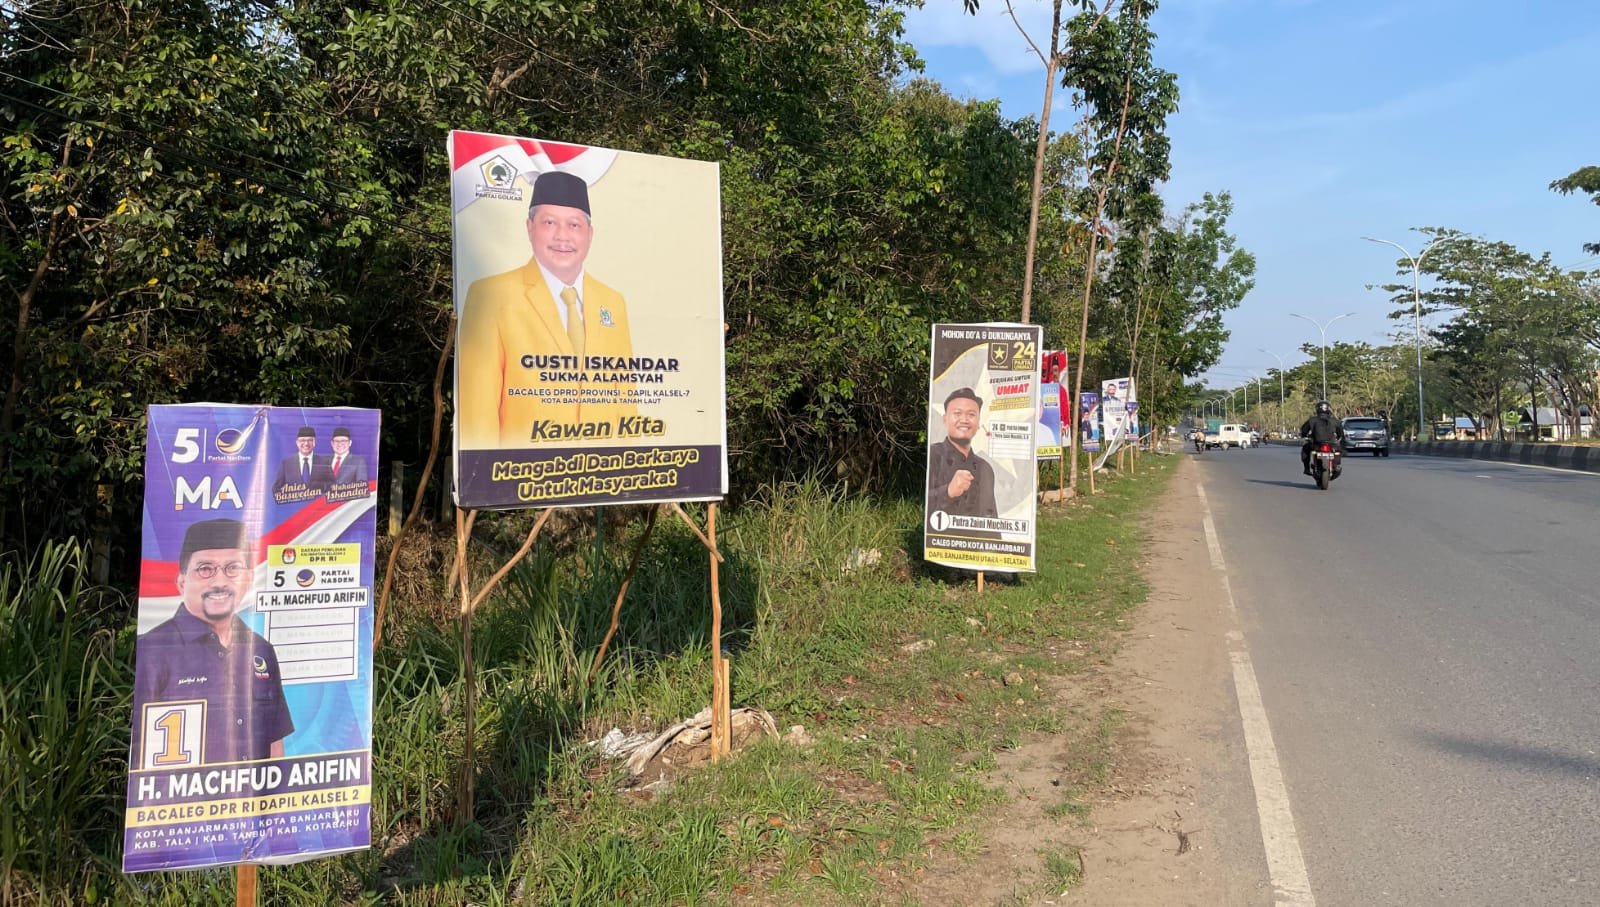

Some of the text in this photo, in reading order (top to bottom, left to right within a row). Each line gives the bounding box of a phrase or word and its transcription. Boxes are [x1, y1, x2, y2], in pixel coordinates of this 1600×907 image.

[941, 330, 964, 339] MOHON
[988, 331, 1032, 340] DUKUNGANYA
[1013, 342, 1036, 359] 24
[520, 354, 680, 371] GUSTI ISKANDAR
[540, 371, 663, 383] SUKMA ALAMSYAH
[508, 388, 551, 396] BACALEG
[580, 389, 621, 397] PROVINSI
[627, 389, 652, 397] DAPIL
[653, 389, 690, 397] KALSEL-7
[996, 383, 1030, 395] UMMAT
[530, 416, 665, 441] Kawan Kita
[171, 428, 200, 464] 5
[493, 448, 699, 480] Mengabdi Dan Berkarya
[175, 475, 243, 511] MA
[281, 482, 306, 494] Anies
[325, 487, 369, 500] Iskandar
[518, 470, 677, 500] Untuk Masyarakat
[274, 488, 322, 501] Baswedan
[936, 511, 942, 530] 1
[952, 516, 969, 526] Putra
[931, 538, 1026, 553] CALEG DPRD KOTA BANJARBARU
[274, 570, 285, 587] 5
[259, 590, 366, 607] 1. H. MACHFUD ARIFIN
[153, 708, 192, 766] 1
[137, 757, 361, 801] H. MACHFUD ARIFIN
[137, 789, 360, 823] BACALEG DPR RI DAPIL KALSEL 2
[135, 829, 165, 840] KOTA
[169, 821, 247, 836] BANJARMASIN
[259, 816, 286, 827] KOTA
[289, 809, 360, 824] BANJARBARU
[134, 838, 161, 850] KAB.
[165, 837, 192, 847] TALA
[203, 834, 229, 843] KAB.
[277, 825, 302, 835] KAB.
[305, 818, 360, 833] KOTABARU
